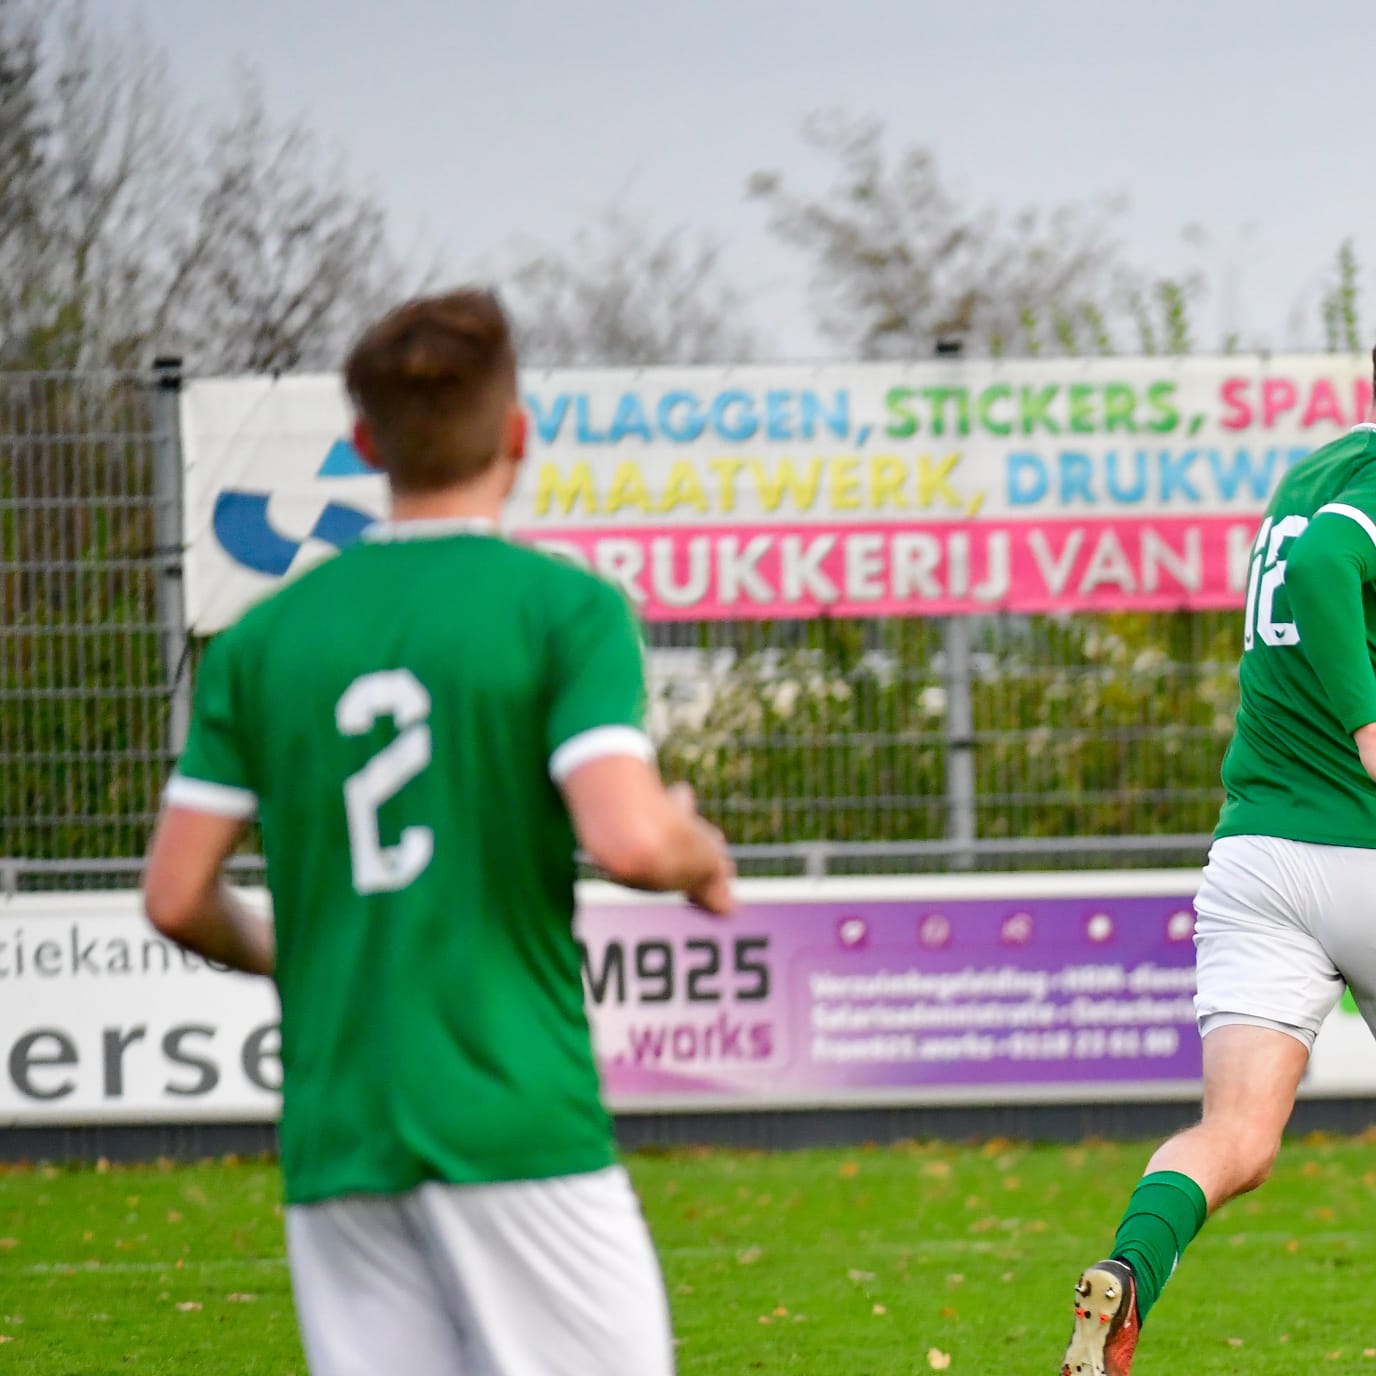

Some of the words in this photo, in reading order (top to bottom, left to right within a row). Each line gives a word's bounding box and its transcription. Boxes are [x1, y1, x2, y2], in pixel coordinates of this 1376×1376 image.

[527, 389, 869, 447] VLAGGEN,
[884, 381, 1206, 439] STICKERS,
[533, 454, 984, 518] MAATWERK,
[335, 667, 435, 896] 2
